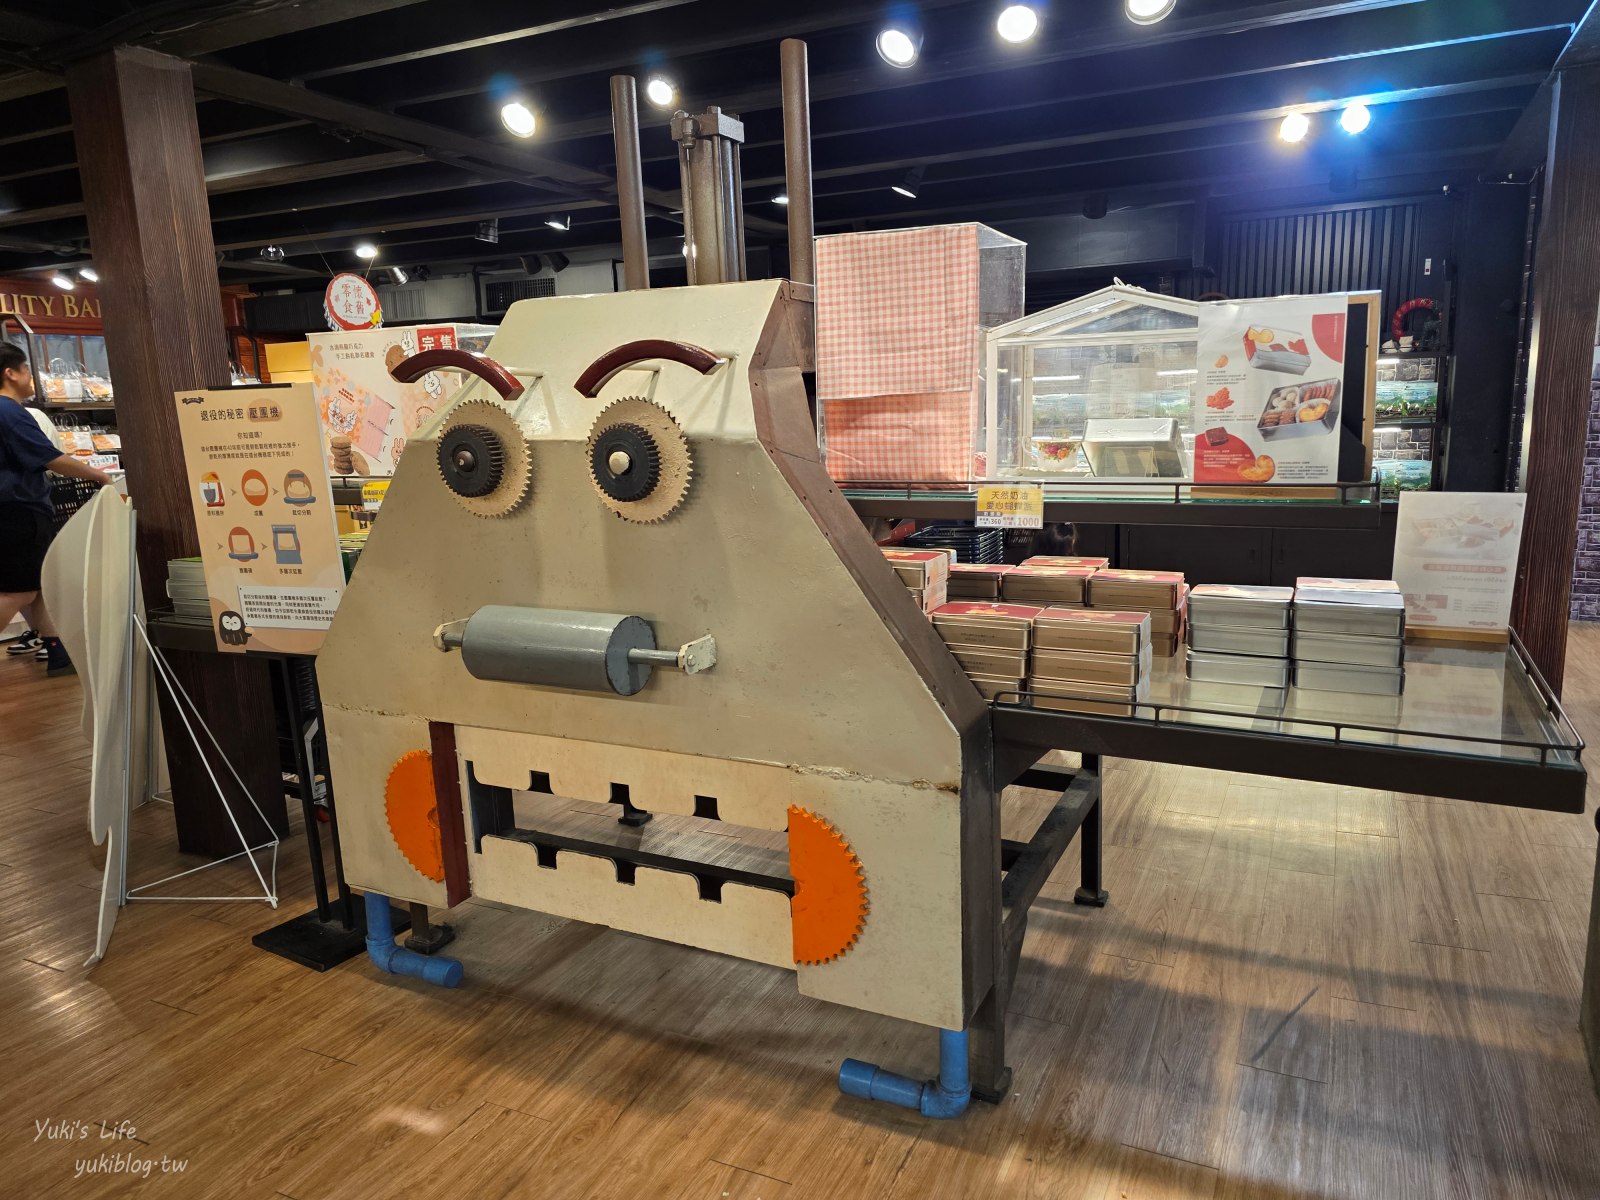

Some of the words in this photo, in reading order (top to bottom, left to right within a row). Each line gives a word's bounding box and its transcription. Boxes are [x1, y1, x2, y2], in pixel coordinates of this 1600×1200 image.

[341, 283, 353, 313] 零食
[421, 334, 453, 351] 完售
[200, 408, 244, 421] 退役的秘密
[991, 490, 1029, 500] 天然奶油
[1017, 517, 1040, 527] 1000
